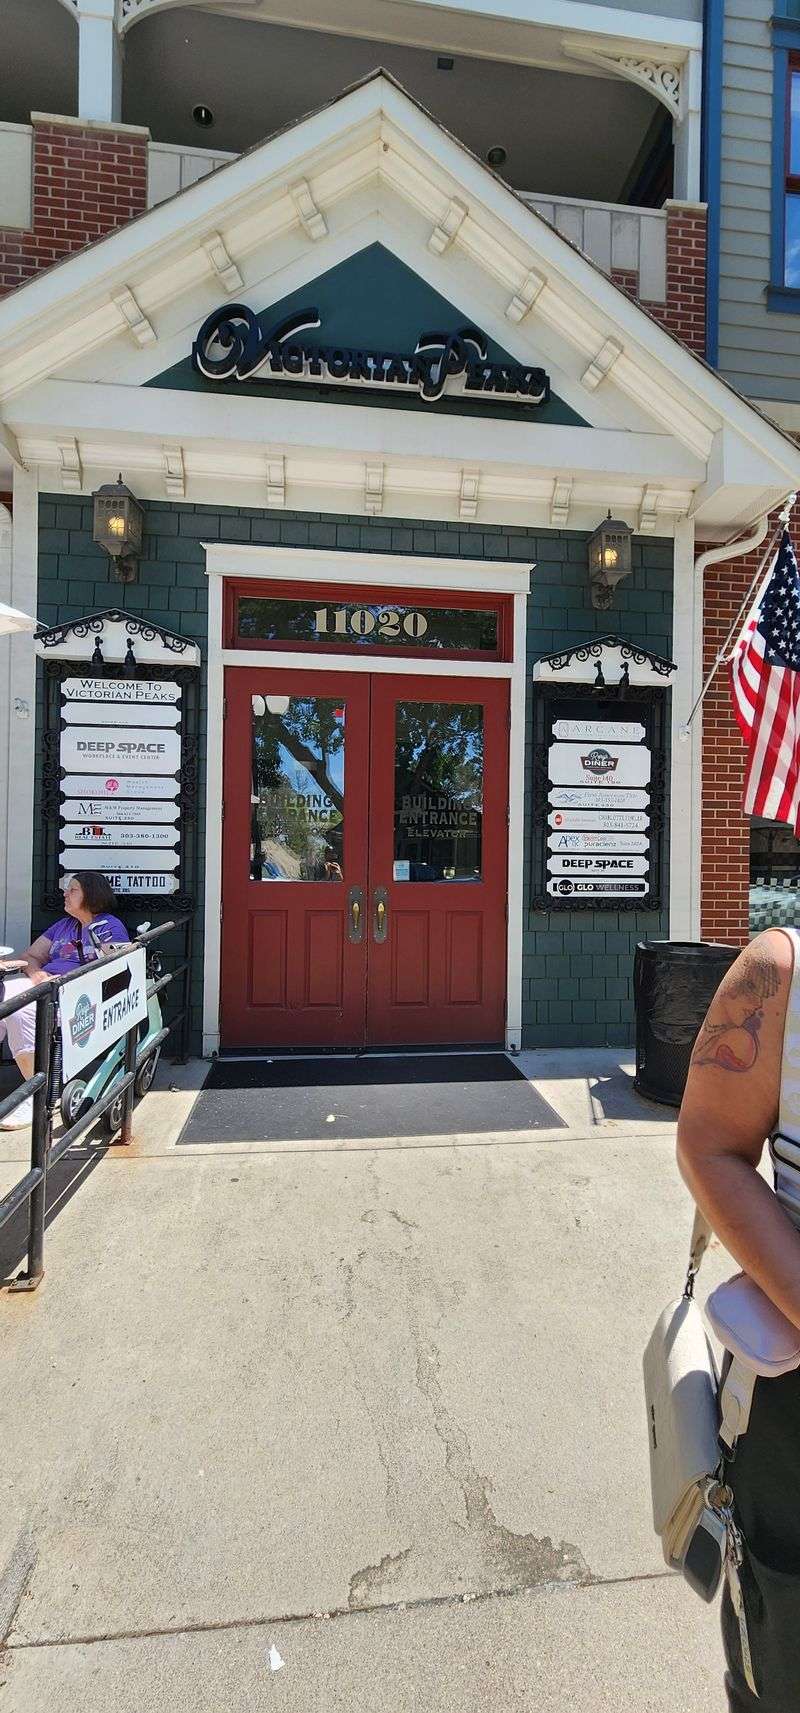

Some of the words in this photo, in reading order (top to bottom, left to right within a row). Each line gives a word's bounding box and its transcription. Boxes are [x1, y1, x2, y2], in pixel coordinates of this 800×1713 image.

[192, 304, 424, 388] VICTORIAN
[415, 328, 550, 403] PEAKS
[313, 608, 428, 637] 11020
[80, 680, 143, 691] WELCOME
[66, 689, 132, 699] VICTORIAN
[135, 690, 176, 700] PEAKS
[573, 725, 640, 733] ARCANE
[76, 741, 115, 753] DEEP
[116, 743, 166, 754] SPACE
[402, 795, 474, 810] BUILDING
[400, 810, 477, 825] ENTRANCE
[562, 859, 593, 869] DEEP
[594, 860, 634, 869] SPACE
[127, 876, 165, 887] TATTOO
[103, 989, 139, 1031] ENTRANCE
[72, 1012, 95, 1036] DINER
